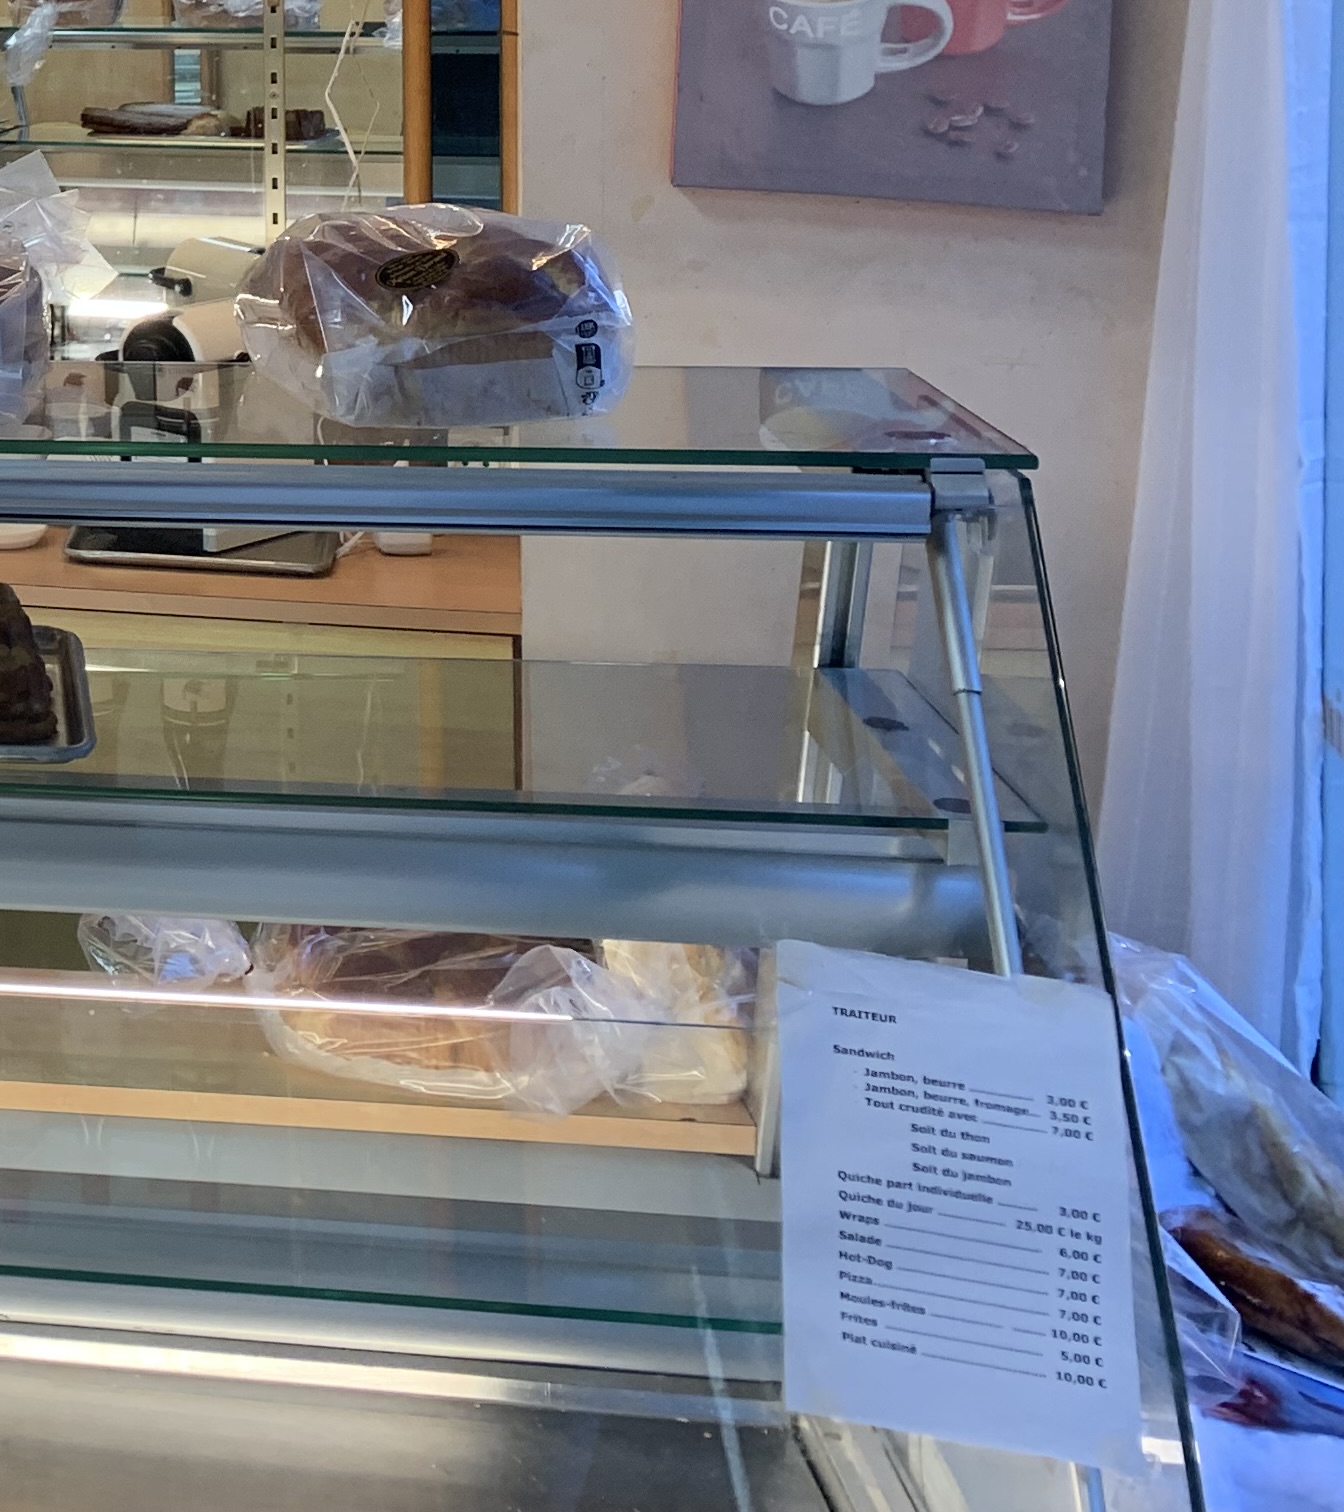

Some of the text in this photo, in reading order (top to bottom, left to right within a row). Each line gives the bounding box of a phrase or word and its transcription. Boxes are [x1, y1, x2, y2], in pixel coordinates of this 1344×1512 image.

[768, 4, 864, 39] CAFÉ
[832, 1006, 898, 1024] TRAITEUR
[833, 1044, 895, 1061] Sandwich
[864, 1067, 1090, 1110] Jambon, beurre 3,00 €
[864, 1082, 919, 1099] Jambon,
[923, 1090, 969, 1106] beurre,
[1049, 1110, 1080, 1125] 3,50
[1082, 1115, 1092, 1126] €
[866, 1097, 1094, 1142] Tout crudité avec 7,00 €
[910, 1123, 991, 1144] Soit du thon
[911, 1142, 1014, 1167] Soit du saumon
[912, 1162, 1012, 1187] Soit du jambon
[838, 1170, 1101, 1223] Quiche part individuelle 3,00 €
[838, 1190, 1103, 1245] Quiche du jour 25,00 € le kg
[839, 1210, 1102, 1264] Wraps 6,00 €
[839, 1230, 1101, 1285] Salade 7,00 €
[839, 1250, 1101, 1305] Hot-Dog 7,00 €
[839, 1270, 1103, 1326] Pizza 7,00 €
[840, 1311, 1104, 1368] Frites 5,00 €
[841, 1330, 1108, 1389] Plat cuisiné 10,00 €
[1051, 1329, 1090, 1344] 10,00
[1093, 1336, 1102, 1347] €
